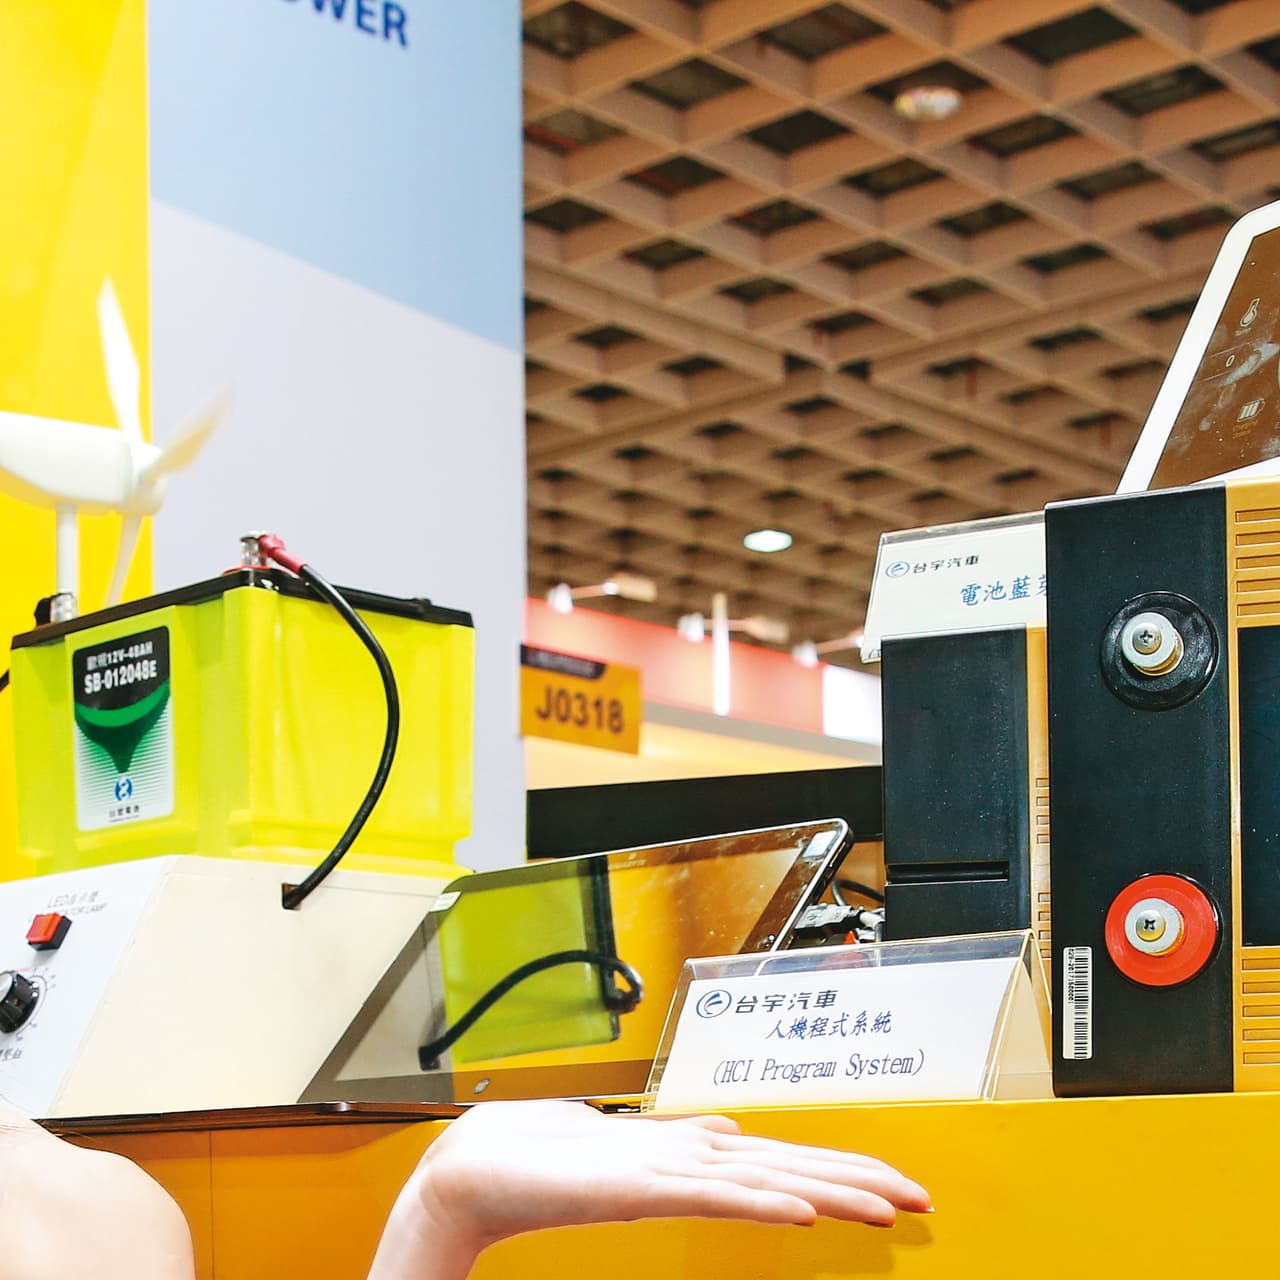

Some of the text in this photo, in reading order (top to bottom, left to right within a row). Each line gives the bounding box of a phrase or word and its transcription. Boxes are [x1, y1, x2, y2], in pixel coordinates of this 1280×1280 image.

[535, 685, 624, 735] J0318
[735, 989, 839, 1014] 台宇汽車
[764, 1010, 893, 1041] 人機程式系統
[713, 1049, 925, 1086] (HCI Program System)
